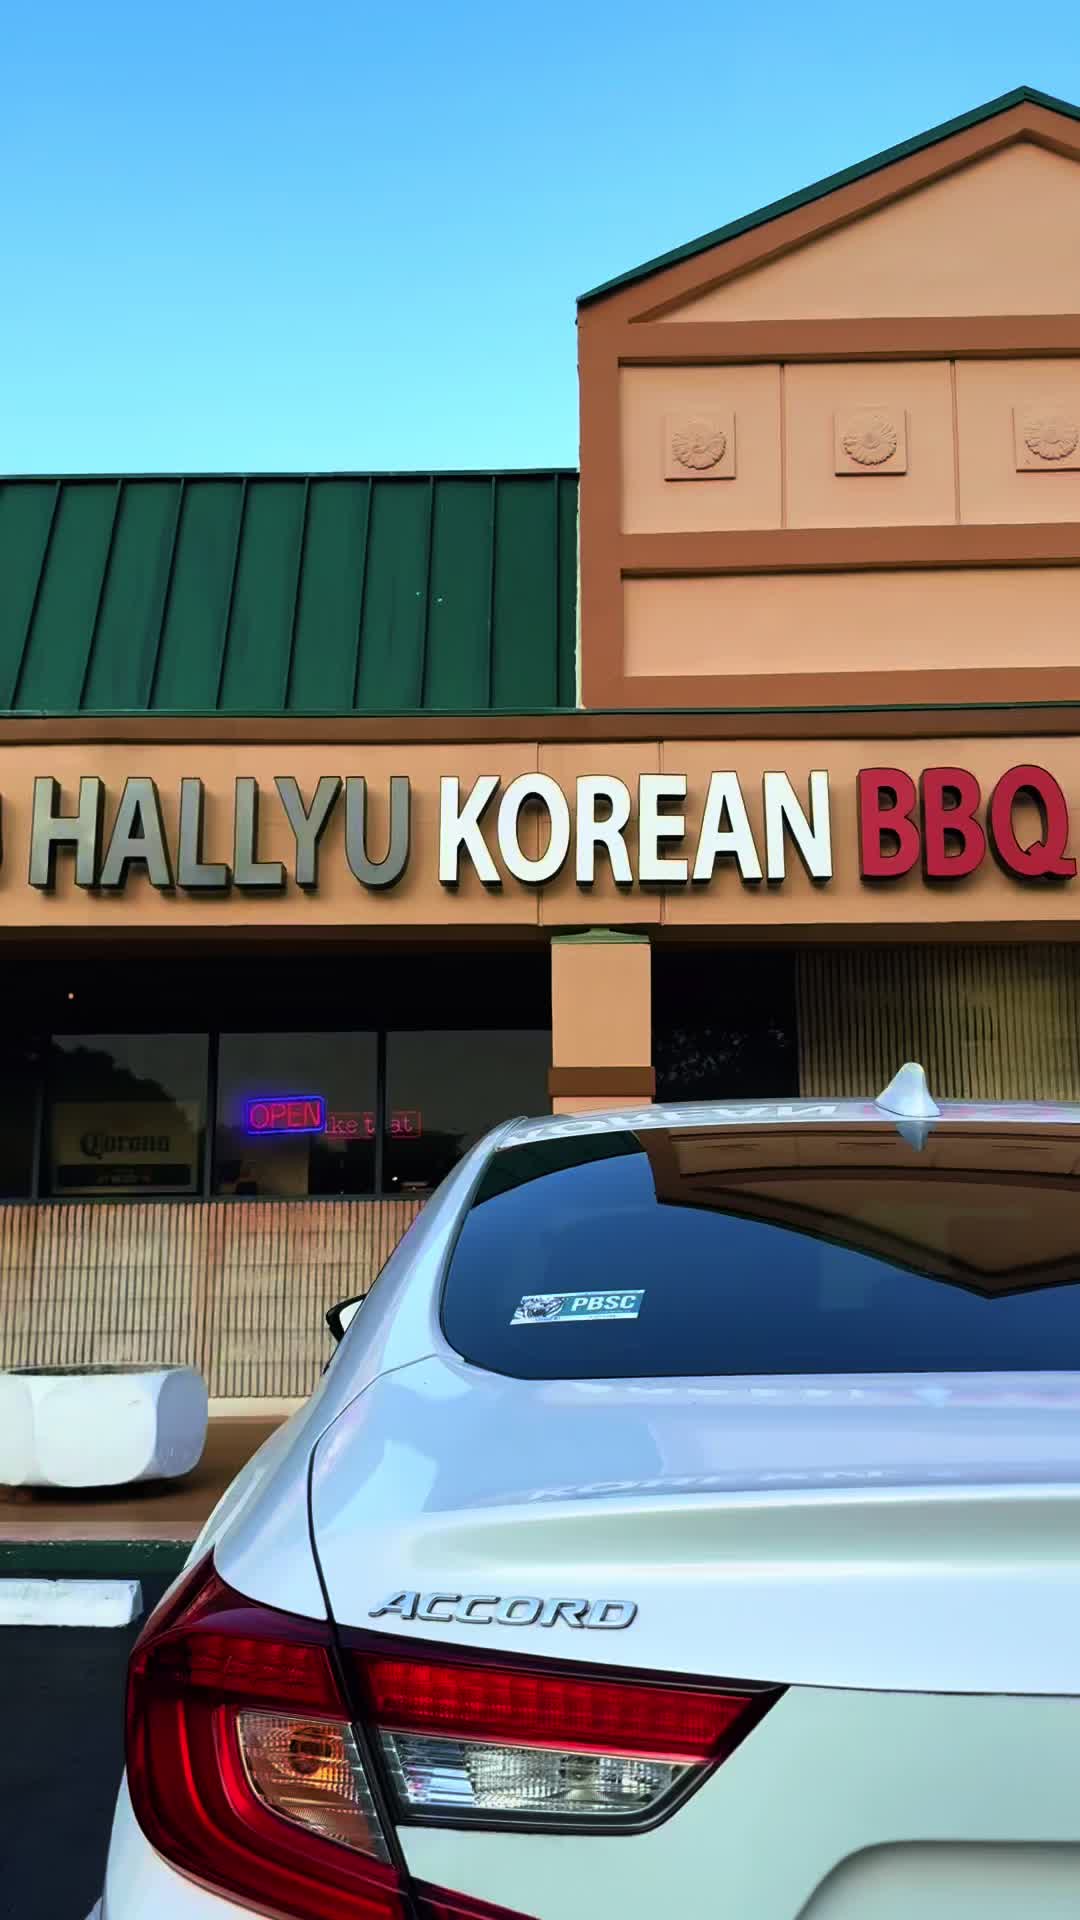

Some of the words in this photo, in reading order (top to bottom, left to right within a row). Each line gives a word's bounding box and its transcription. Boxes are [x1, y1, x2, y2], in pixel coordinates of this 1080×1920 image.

[28, 775, 411, 889] HALLYU
[438, 769, 833, 888] KOREAN
[856, 764, 1077, 881] BBQ
[250, 1101, 321, 1129] OPEN
[570, 1294, 636, 1312] PBSC
[367, 1590, 639, 1630] ACCORD
